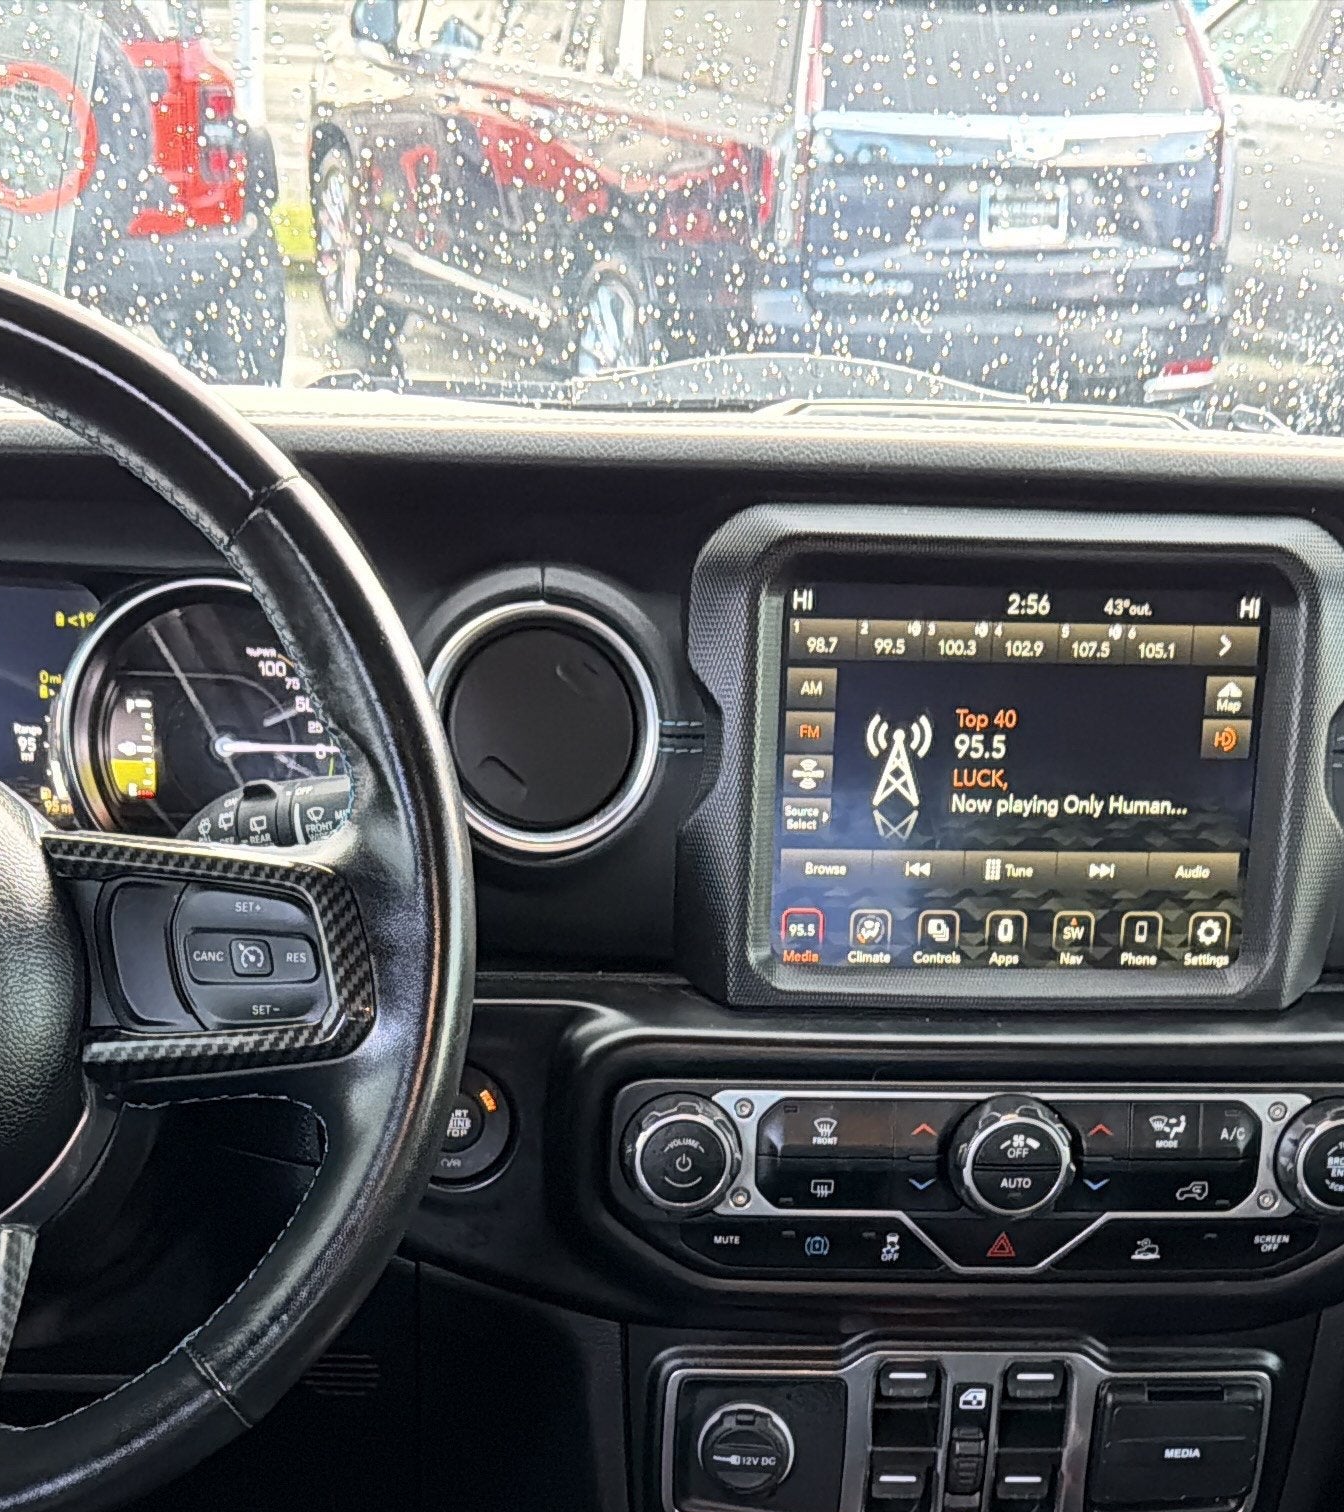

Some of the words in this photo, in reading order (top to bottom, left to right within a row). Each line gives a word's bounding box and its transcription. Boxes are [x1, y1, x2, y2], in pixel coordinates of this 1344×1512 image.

[792, 588, 814, 611] HI
[1006, 593, 1051, 616] 2:56
[1239, 596, 1261, 619] HI
[806, 636, 839, 654] 98.7
[874, 637, 906, 655] 99.5
[938, 639, 977, 656] 100.3
[1005, 639, 1045, 657] 102.9
[1071, 640, 1111, 659] 107.5
[1138, 642, 1176, 660] 105.1
[257, 660, 287, 678] 100
[800, 680, 823, 696] AM
[1216, 698, 1243, 715] Map
[306, 720, 324, 734] 25
[955, 708, 989, 731] Top
[993, 708, 1018, 729] 40
[799, 724, 822, 740] FM
[954, 733, 1007, 759] 95.5
[952, 768, 1009, 792] LUCK,
[784, 804, 820, 818] Source
[951, 793, 992, 814] Now
[996, 794, 1059, 819] playing
[1063, 794, 1105, 819] Only
[1109, 795, 1188, 816] Human...
[305, 820, 335, 834] FRONT
[786, 818, 818, 831] Select
[249, 833, 272, 844] REAR
[804, 861, 847, 877] Browse
[1005, 863, 1034, 879] Tune
[1174, 863, 1211, 879] Audio
[233, 901, 263, 914] SET+
[788, 923, 816, 937] 95.5
[1062, 926, 1085, 940] SW
[192, 949, 226, 964] CANC
[285, 950, 309, 964] RES
[783, 950, 819, 964] Media
[847, 950, 891, 965] Climate
[912, 950, 962, 965] Controls
[988, 951, 1020, 967] Apps
[1059, 952, 1084, 966] Nav
[1120, 952, 1158, 967] Phone
[1183, 952, 1231, 969] Settings
[812, 1136, 839, 1146] FRONT
[1219, 1126, 1246, 1143] A/C
[666, 1137, 702, 1151] VOLUME
[1155, 1139, 1179, 1149] MODE
[1007, 1147, 1030, 1159] OFF
[999, 1177, 1033, 1190] AUTO
[713, 1235, 741, 1246] MUTE
[1254, 1234, 1291, 1246] SCREEN
[1260, 1243, 1281, 1253] OFF
[880, 1252, 900, 1262] OFF
[742, 1455, 759, 1466] 12V
[760, 1456, 777, 1467] DC
[1163, 1447, 1202, 1460] MEDIA
